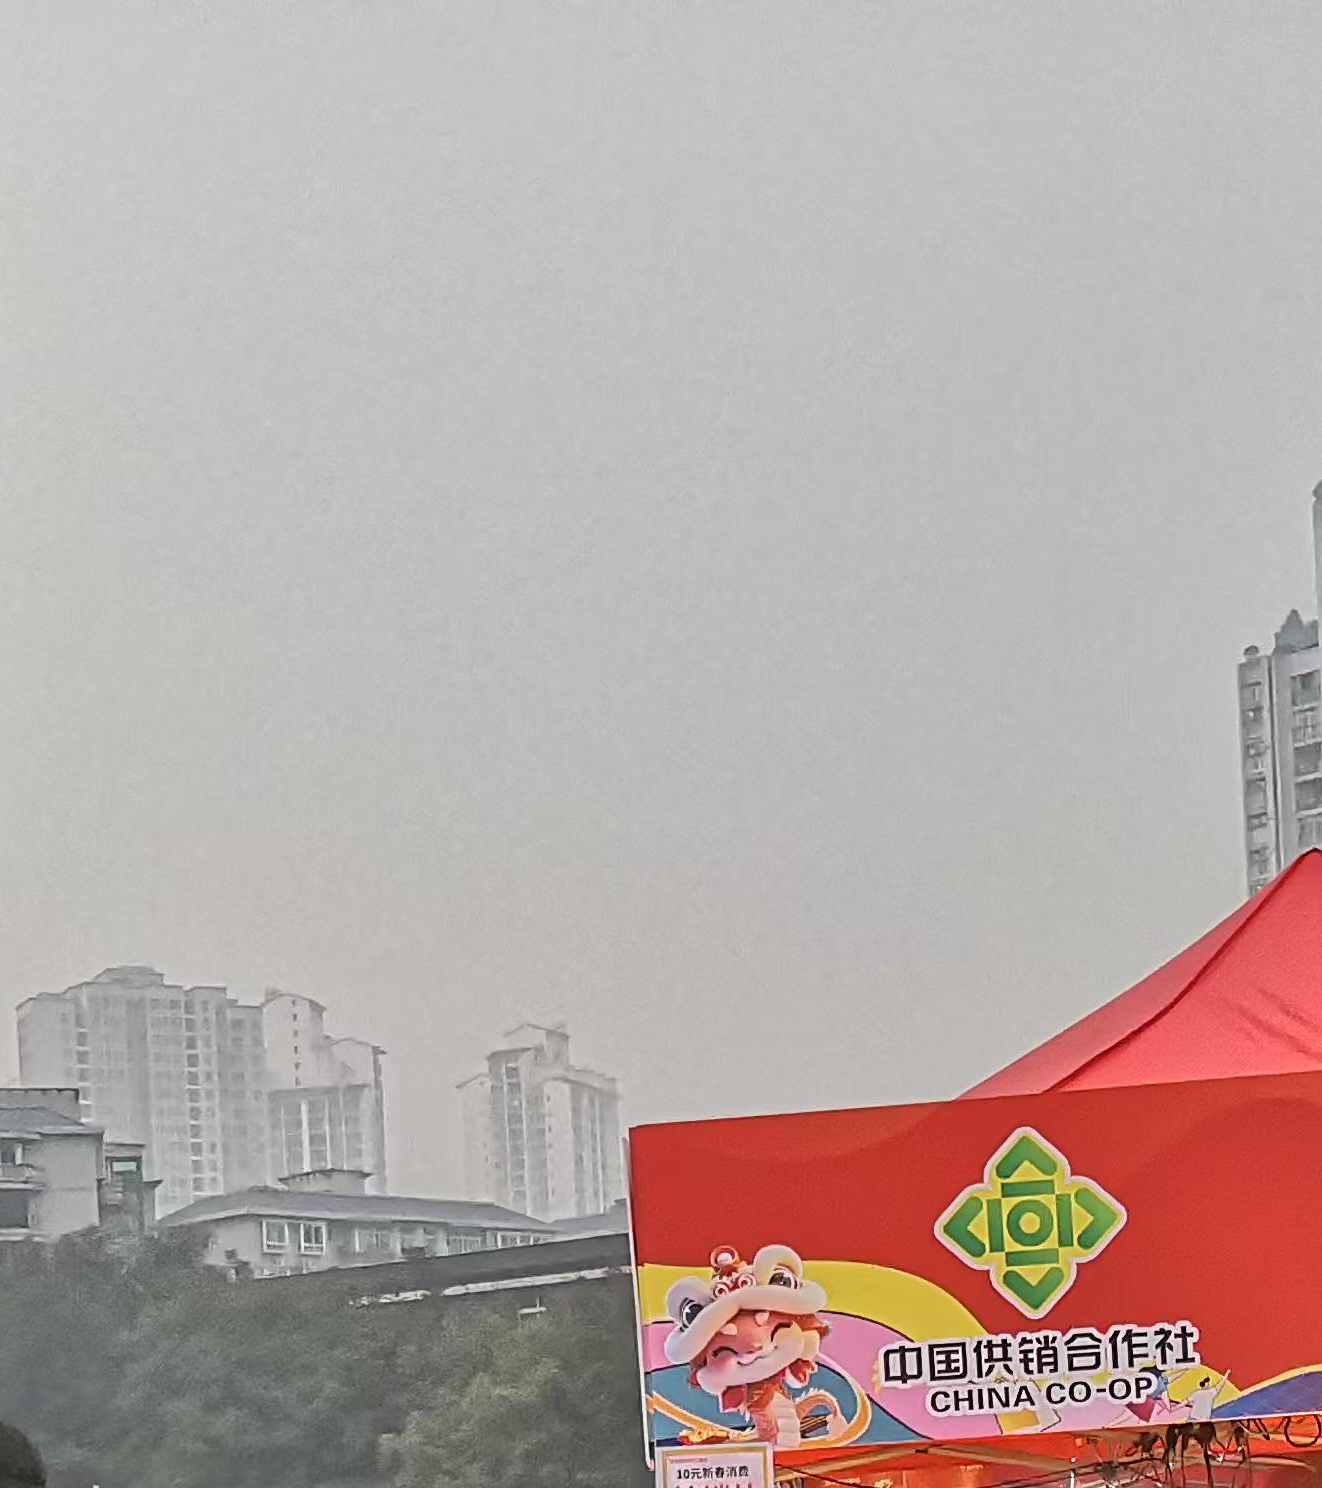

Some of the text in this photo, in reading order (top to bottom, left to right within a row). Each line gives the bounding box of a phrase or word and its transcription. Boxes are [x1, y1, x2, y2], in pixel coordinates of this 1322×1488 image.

[884, 1326, 1197, 1384] 中国供销合作社
[930, 1376, 1153, 1413] CHINA CO-OP
